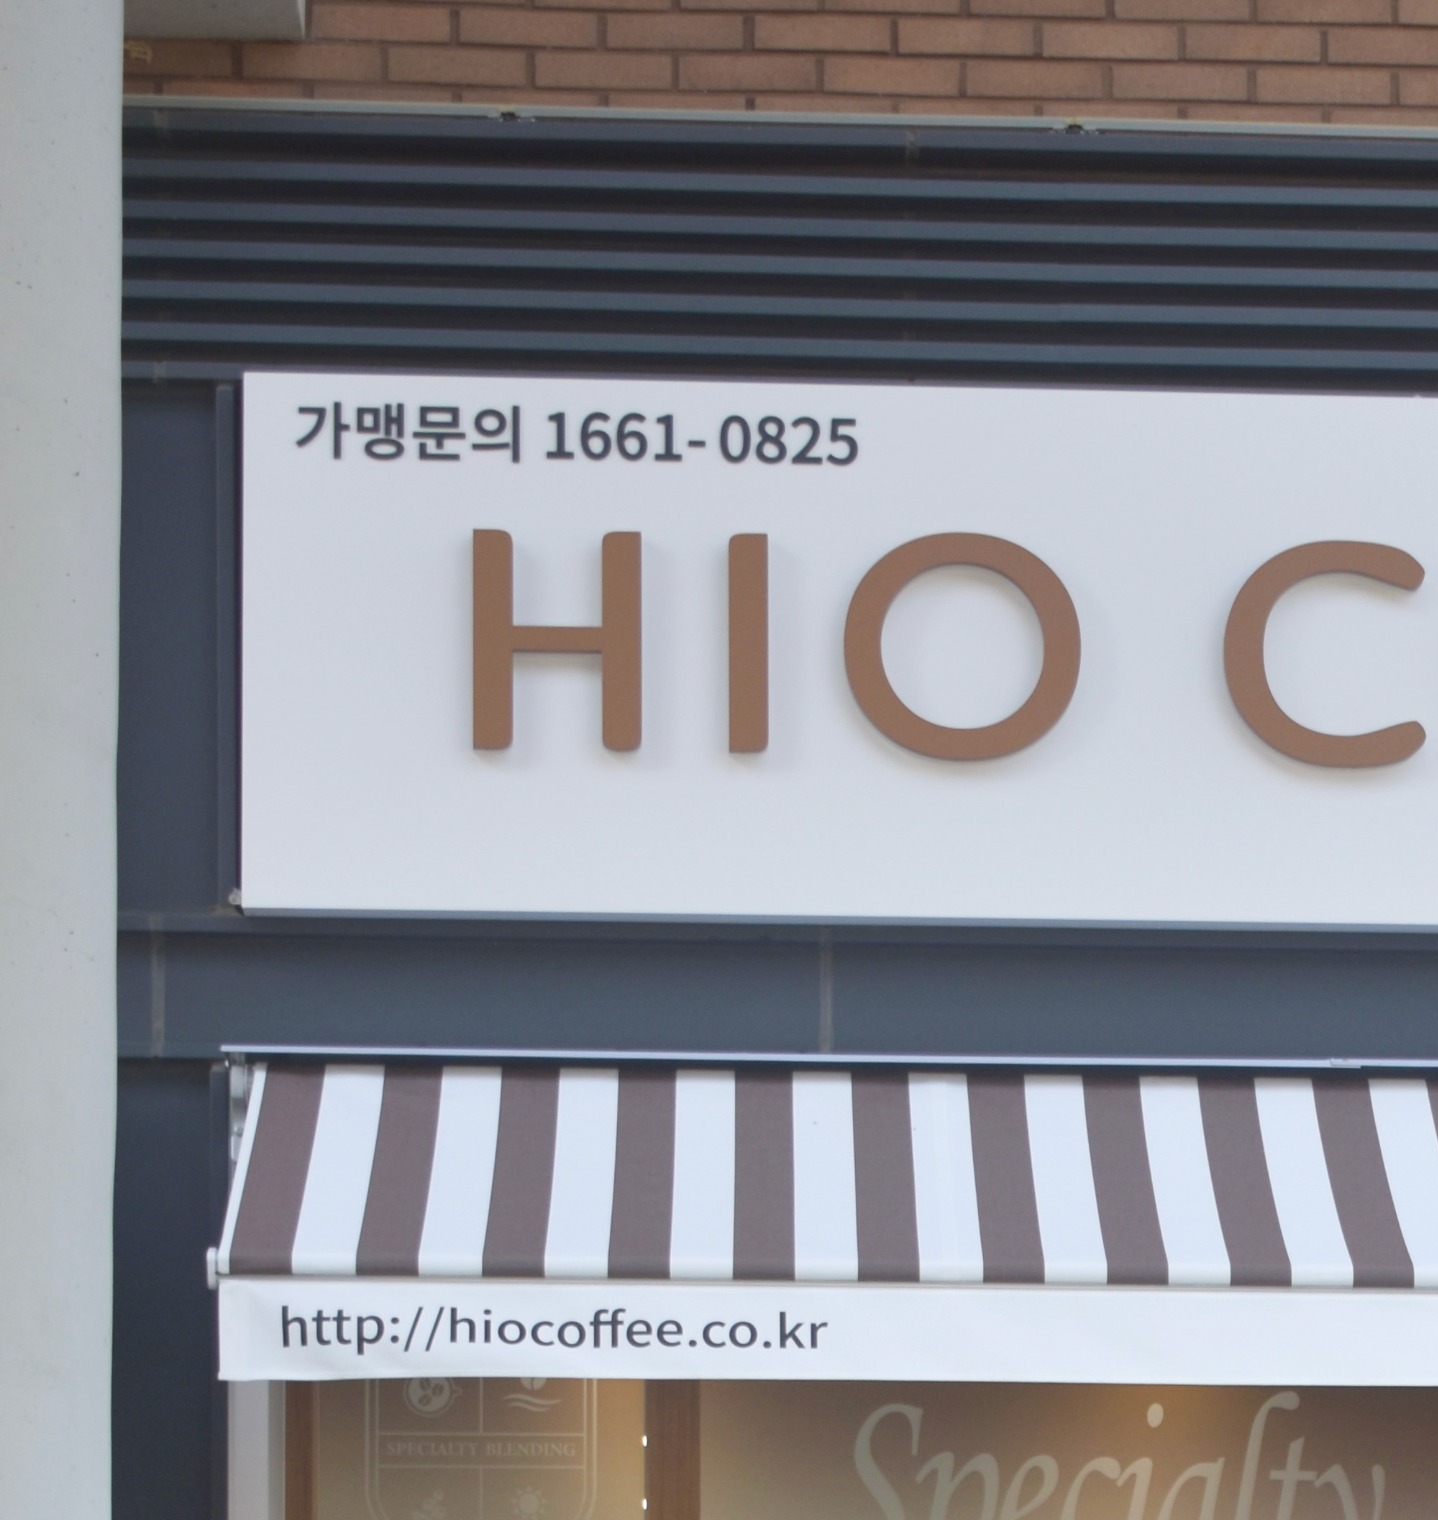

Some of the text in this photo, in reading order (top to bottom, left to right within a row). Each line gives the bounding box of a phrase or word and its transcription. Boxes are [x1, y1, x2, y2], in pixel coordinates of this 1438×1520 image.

[294, 402, 860, 468] 가맹문의 1661-0825
[472, 528, 1082, 762] HIO
[280, 1304, 828, 1355] http://hiocoffee.co.kr
[386, 1440, 577, 1457] SPECIALTY BLENDING
